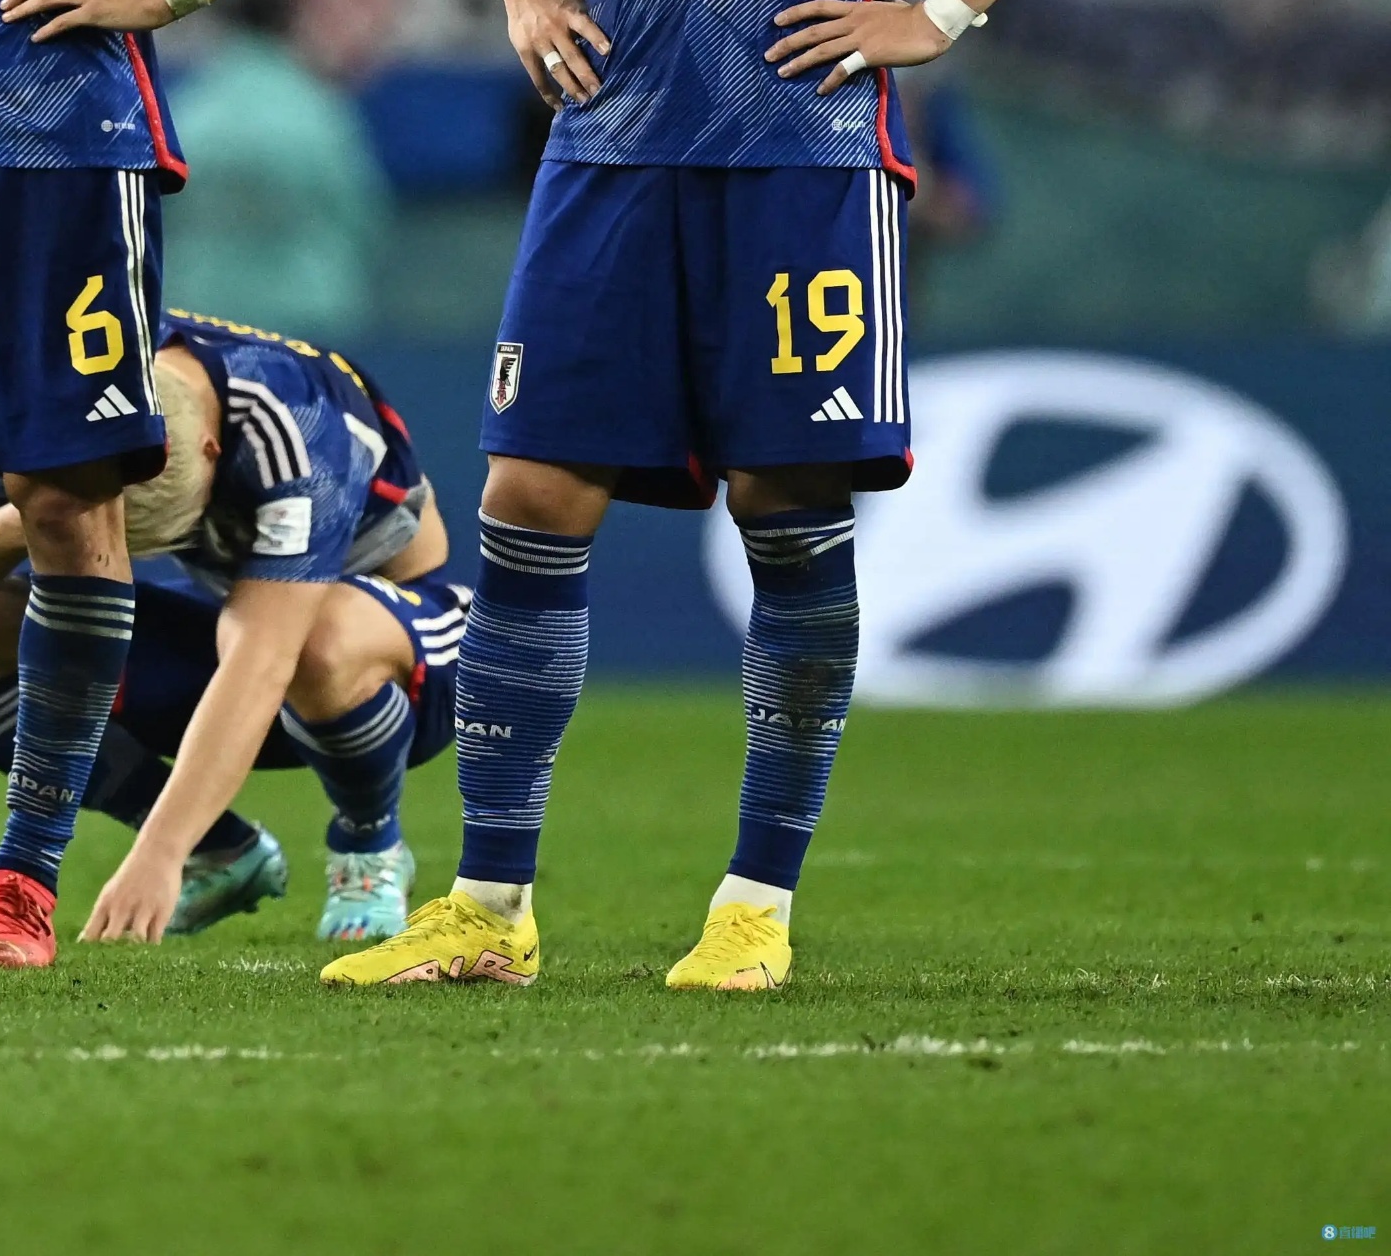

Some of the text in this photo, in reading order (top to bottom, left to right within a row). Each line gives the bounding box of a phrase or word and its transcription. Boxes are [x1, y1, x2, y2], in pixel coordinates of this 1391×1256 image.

[65, 274, 124, 375] 6
[765, 269, 865, 374] 19
[454, 714, 513, 739] PAN
[8, 771, 75, 802] APAN
